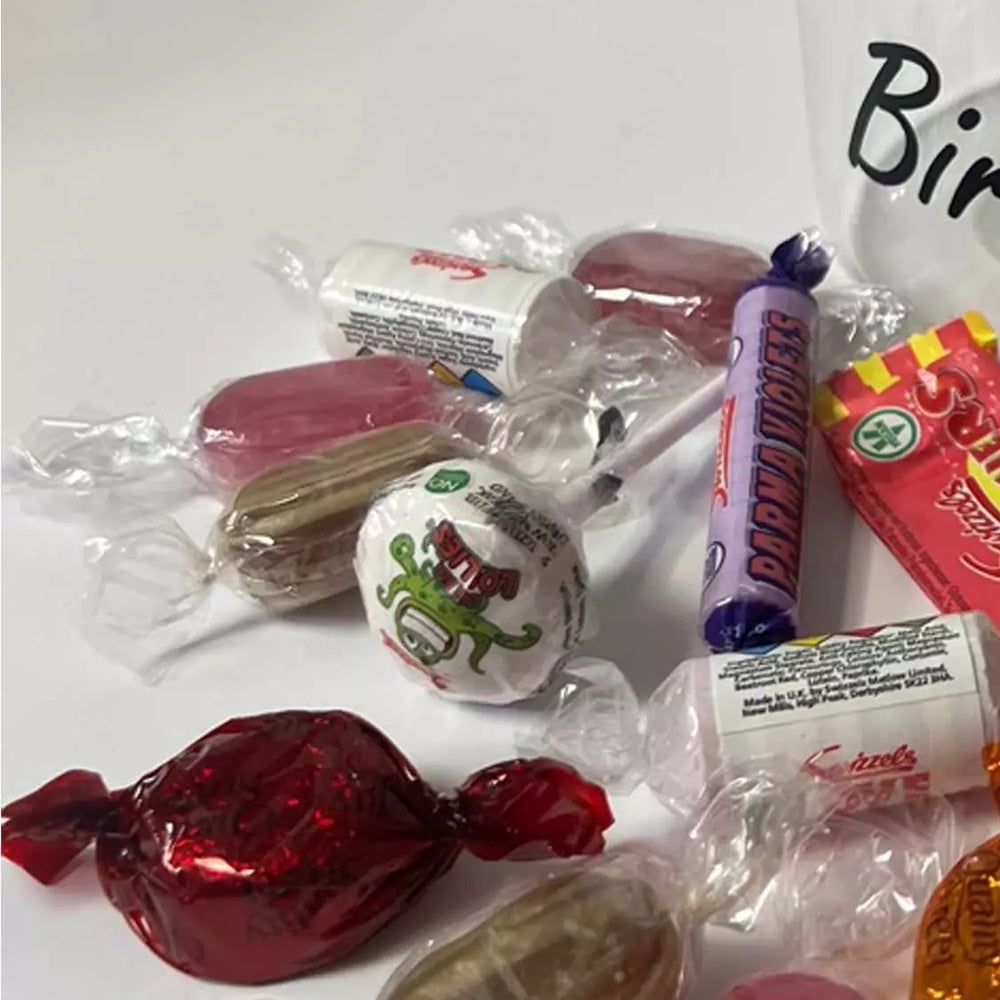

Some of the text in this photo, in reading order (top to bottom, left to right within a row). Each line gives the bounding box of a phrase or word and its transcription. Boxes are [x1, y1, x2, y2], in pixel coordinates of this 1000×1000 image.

[745, 309, 812, 599] PARMA VIOLETS
[804, 744, 917, 779] Sizzels
